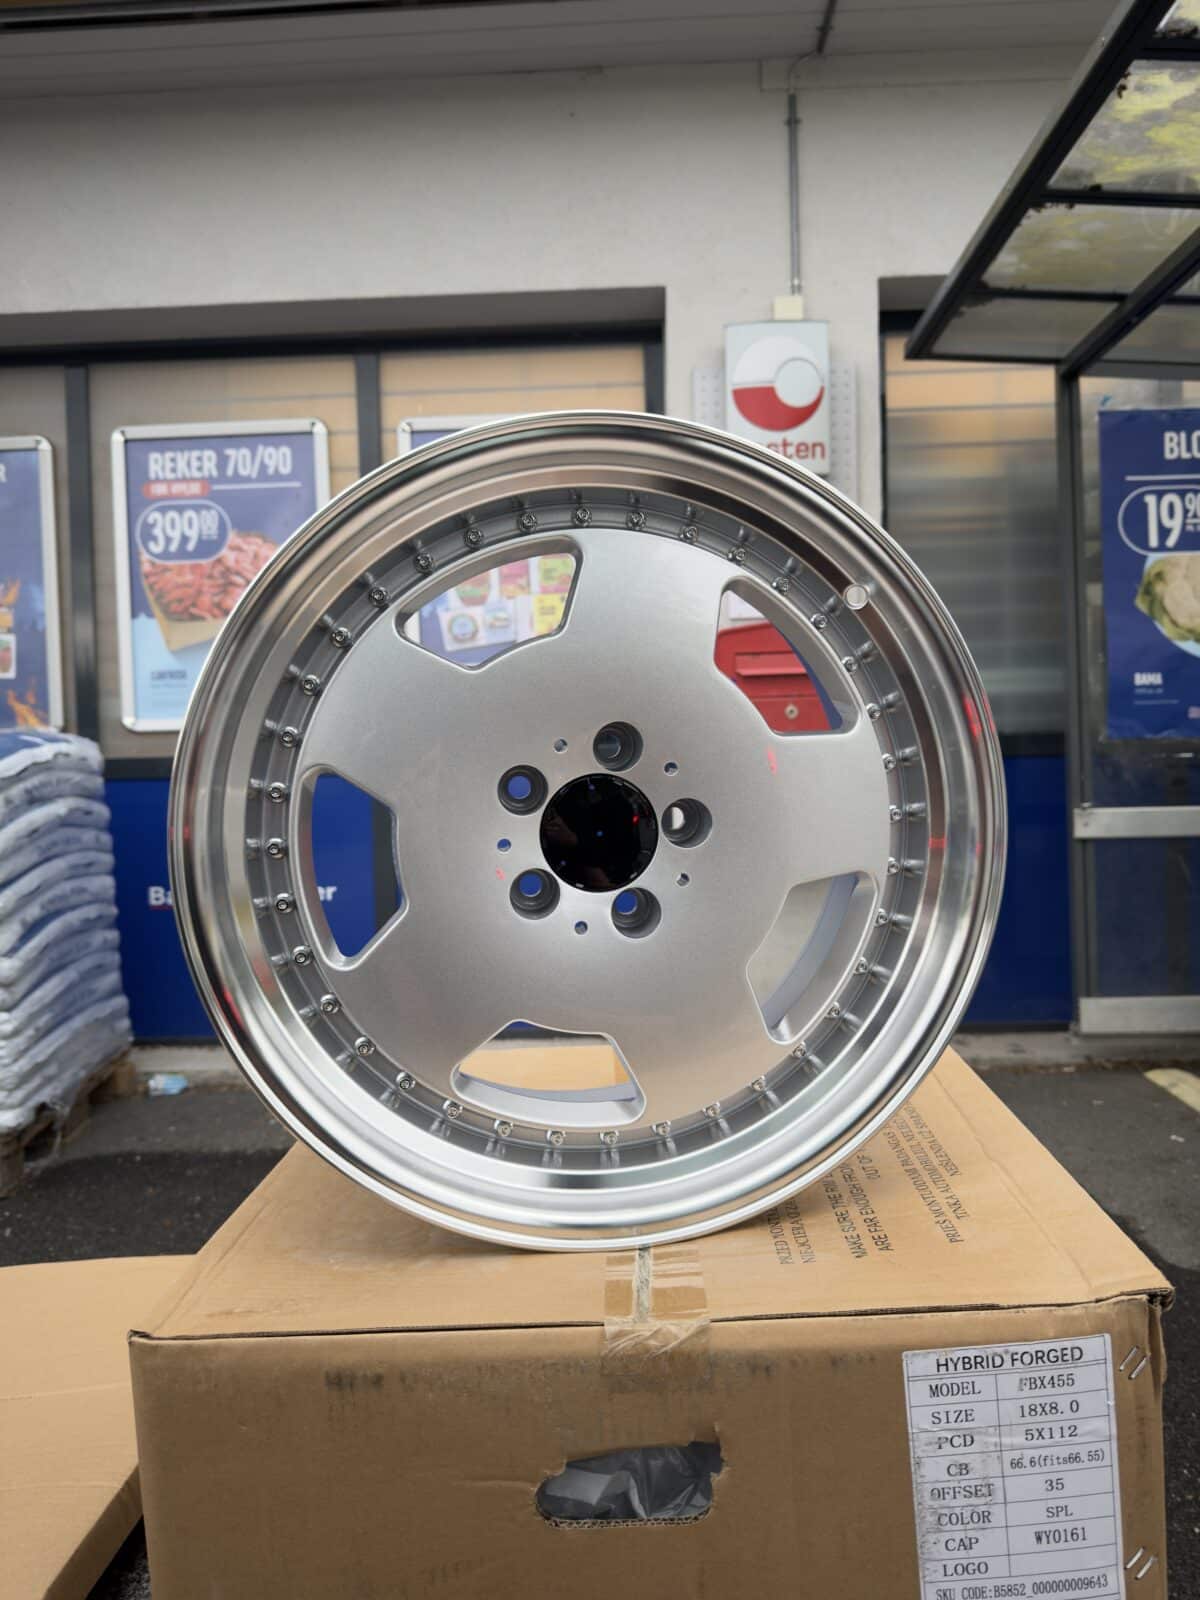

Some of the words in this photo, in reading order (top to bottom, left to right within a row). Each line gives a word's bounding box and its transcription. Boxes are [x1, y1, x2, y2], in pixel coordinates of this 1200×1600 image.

[149, 450, 218, 480] REKER
[224, 444, 294, 479] 70/90
[147, 509, 199, 554] 399
[1144, 493, 1183, 548] 19
[863, 1216, 884, 1233] FAR
[845, 1233, 868, 1258] MAKE
[872, 1233, 894, 1251] ARE
[936, 1354, 1004, 1373] HYBRID
[1010, 1346, 1084, 1368] FORGED
[929, 1380, 982, 1398] MODEL
[1017, 1373, 1075, 1392] FBX455
[931, 1408, 975, 1425] SIZE
[937, 1433, 974, 1450] PCD
[1025, 1425, 1078, 1442] 5X112
[947, 1463, 970, 1477] CB
[930, 1483, 995, 1501] OFFSET
[1045, 1478, 1065, 1492] 35
[937, 1510, 992, 1527] COLOR
[1046, 1505, 1073, 1518] SPL
[944, 1537, 979, 1552] CAP
[943, 1561, 989, 1577] LOGO
[936, 1588, 956, 1600] SKU
